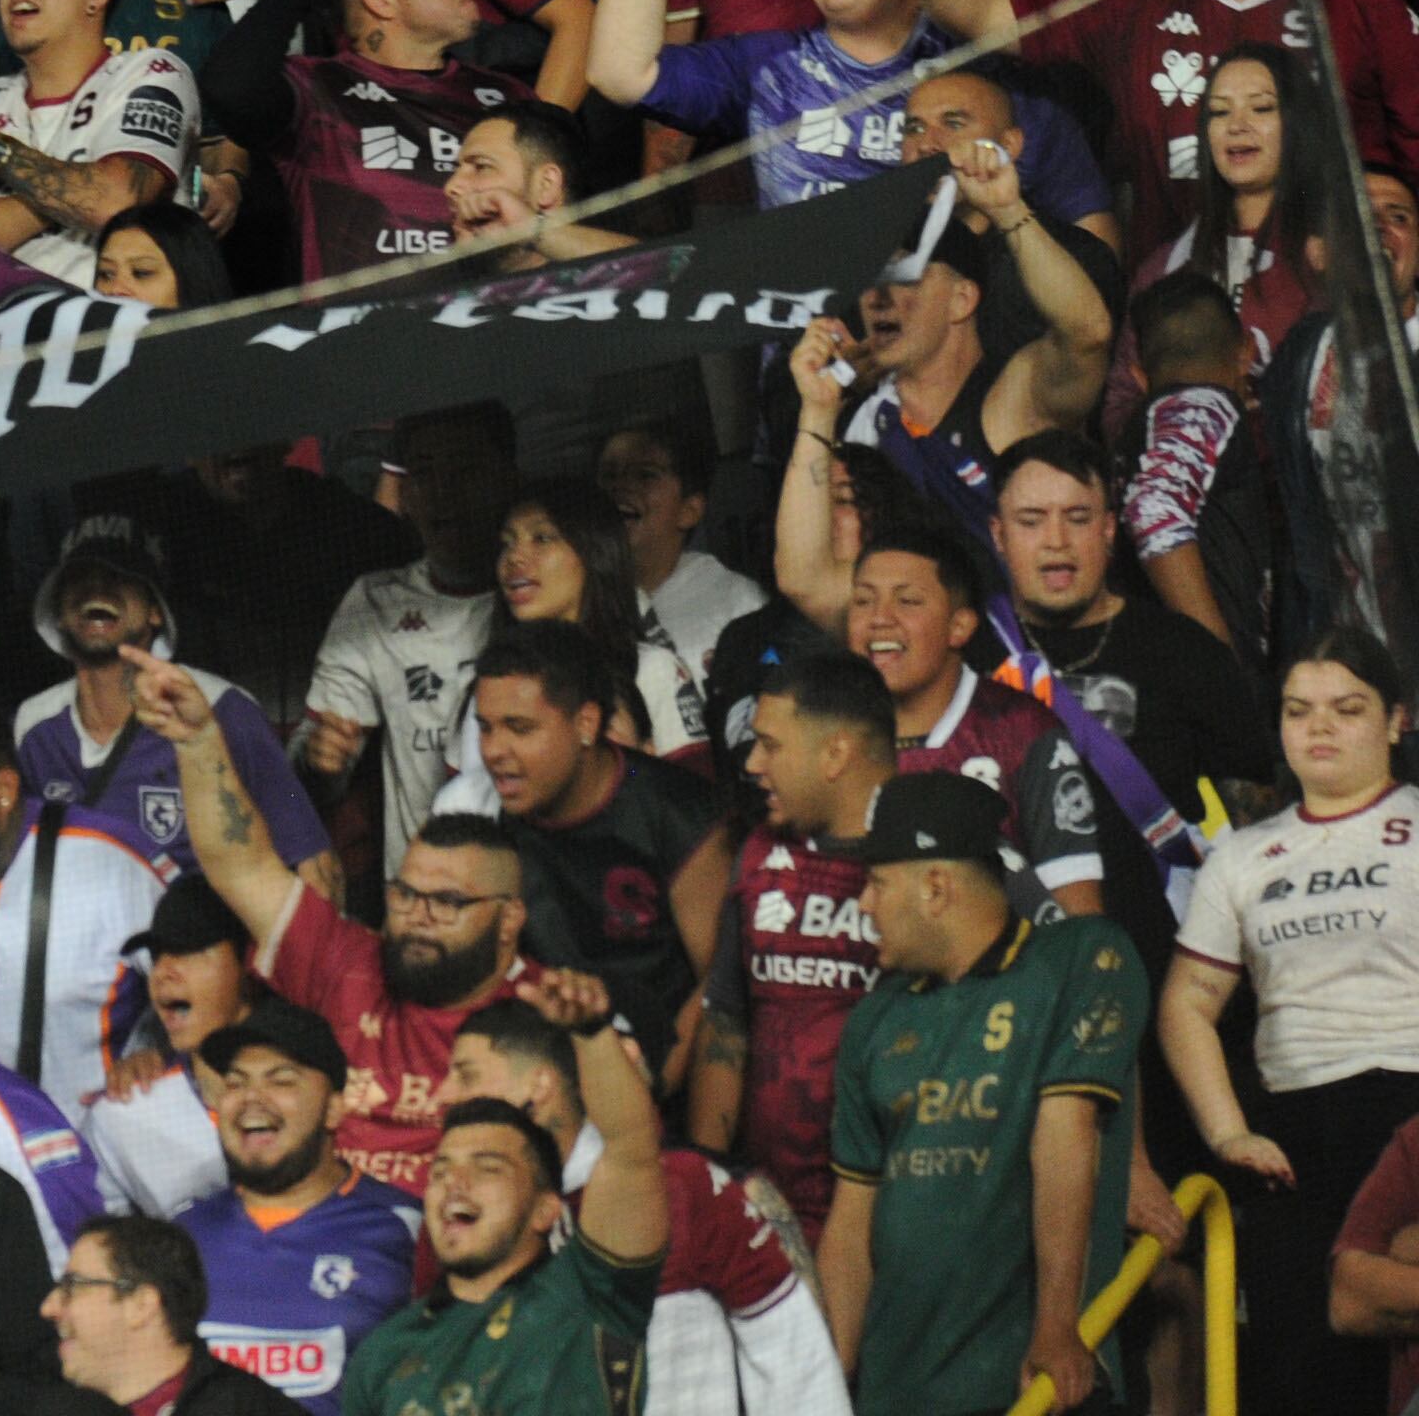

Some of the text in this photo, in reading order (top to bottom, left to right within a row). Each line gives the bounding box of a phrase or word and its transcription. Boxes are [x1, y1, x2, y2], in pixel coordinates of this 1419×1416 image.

[69, 91, 97, 131] S
[121, 113, 183, 141] KING
[125, 100, 184, 125] BURGER
[1380, 818, 1412, 845] S
[1306, 863, 1389, 896] BAC
[1258, 909, 1387, 946] LIBERTY
[751, 955, 881, 992] LIBERTY
[983, 1001, 1014, 1051] S
[917, 1074, 999, 1125] BAC
